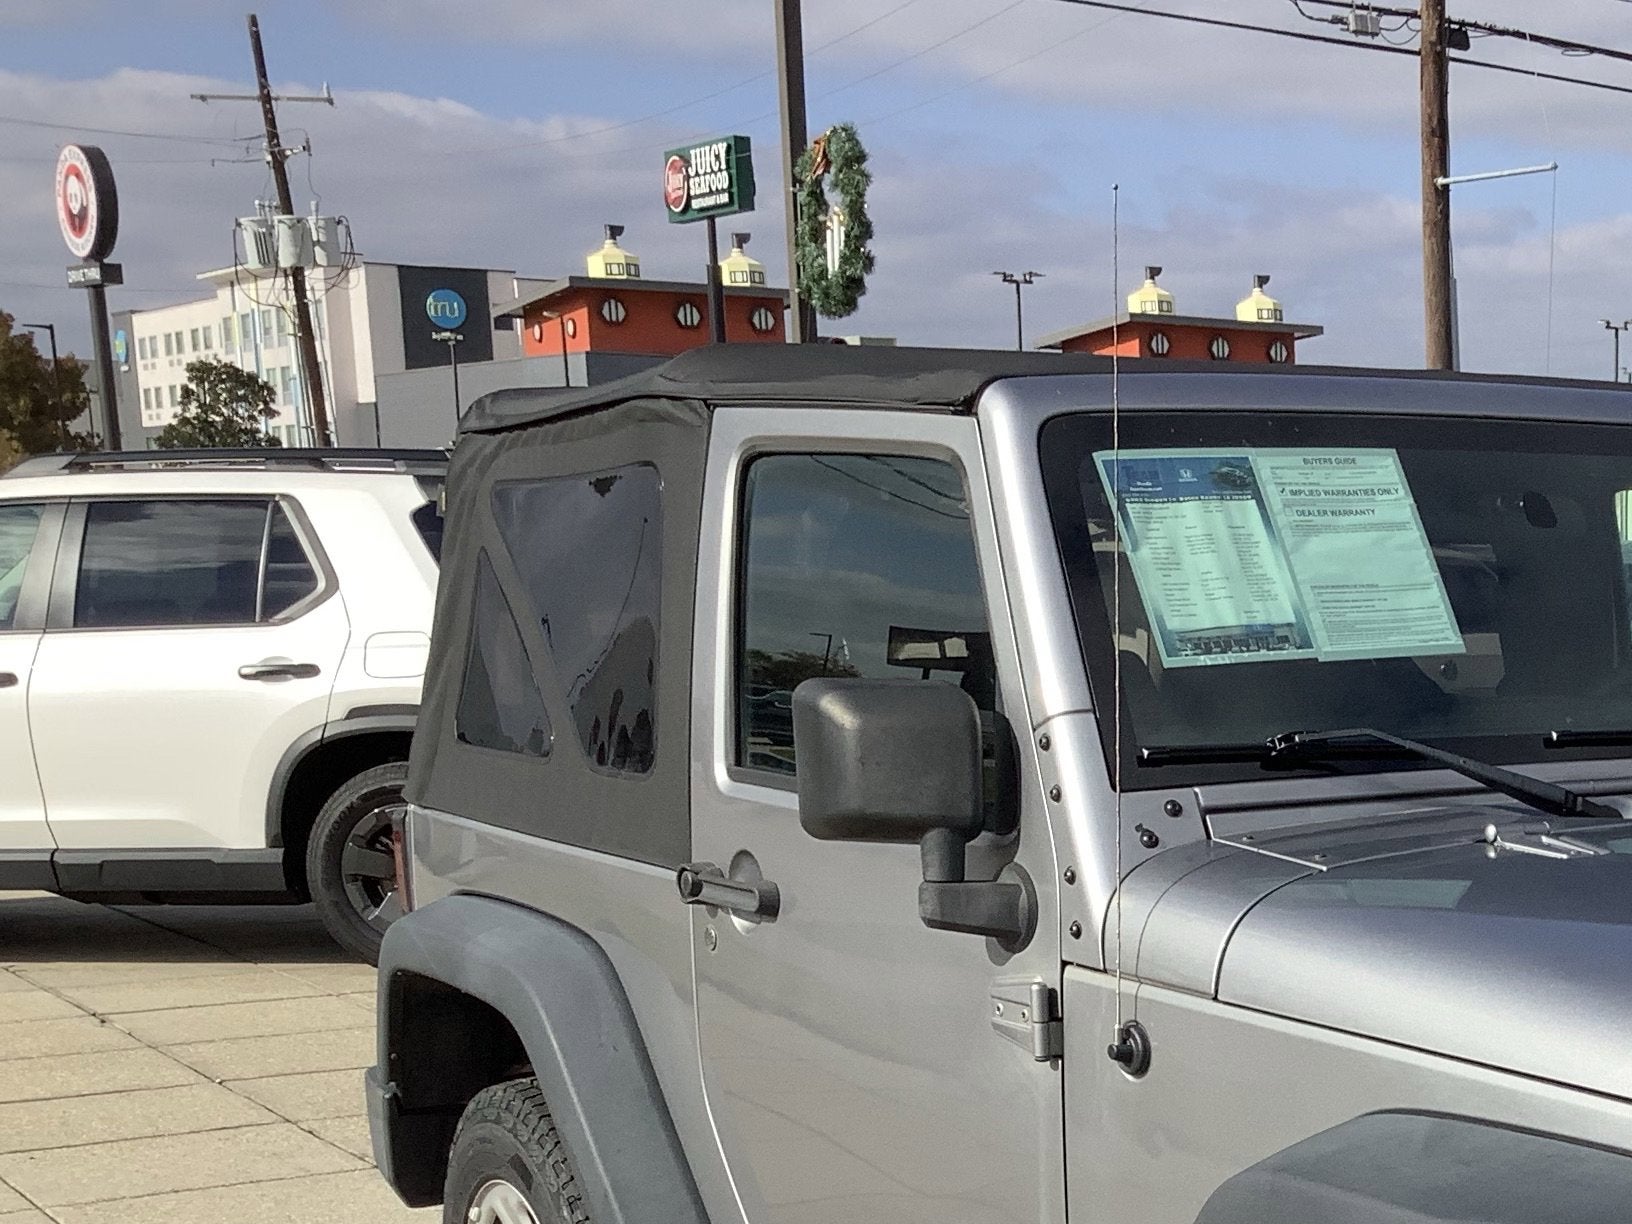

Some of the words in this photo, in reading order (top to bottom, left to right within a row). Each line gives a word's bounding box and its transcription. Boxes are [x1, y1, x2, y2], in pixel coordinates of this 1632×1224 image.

[688, 142, 728, 176] JUICY
[689, 170, 729, 196] SEAFOOD
[1302, 457, 1333, 466] BUYERS
[1334, 457, 1357, 465] GUIDE
[1288, 488, 1322, 497] IMPLIED
[1322, 487, 1377, 497] WARRANTIES
[1377, 487, 1399, 496] ONLY
[1295, 509, 1328, 518] DEALER
[1329, 508, 1376, 518] WARRANTY
